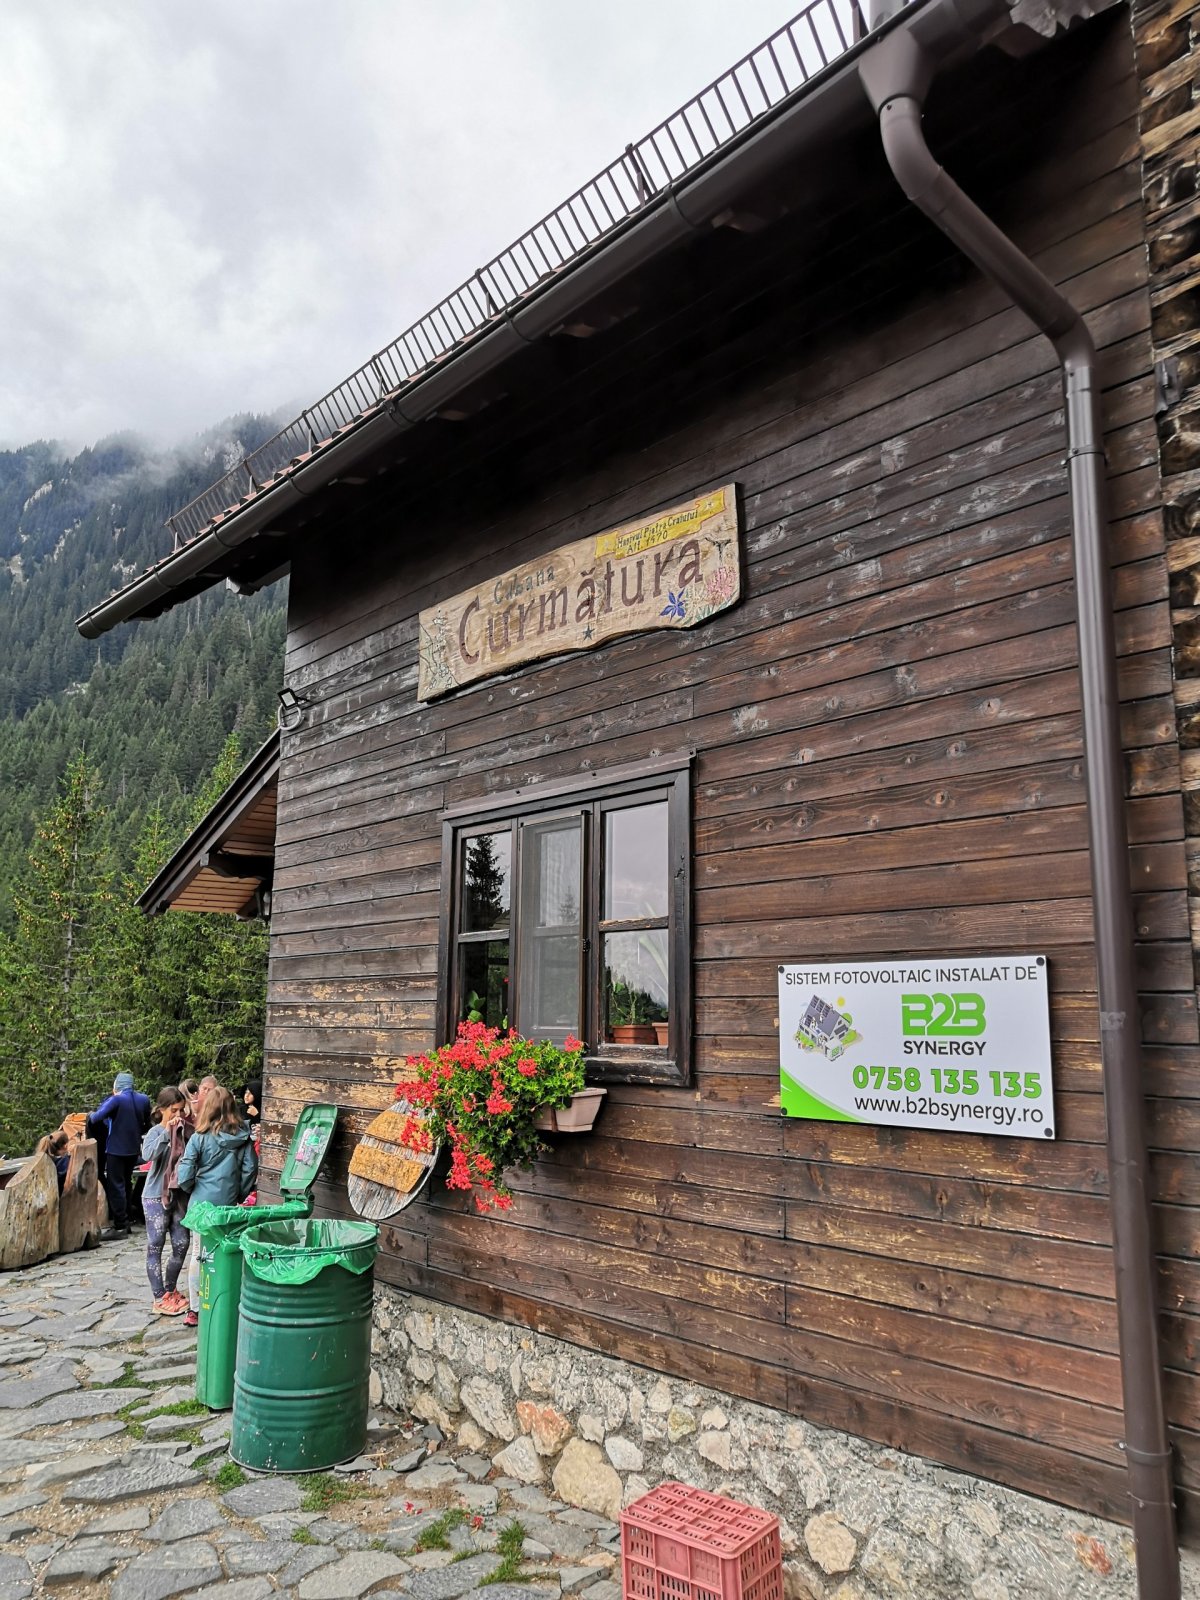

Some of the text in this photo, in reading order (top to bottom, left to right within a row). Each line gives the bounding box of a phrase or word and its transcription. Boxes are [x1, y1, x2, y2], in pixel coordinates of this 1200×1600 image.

[667, 509, 699, 528] Craiului
[493, 565, 555, 604] Cabana
[458, 538, 704, 665] Curmătura
[785, 965, 1038, 985] SISTEM FOTOVOLTAIC INSTALAT DE
[901, 992, 987, 1037] B2B
[903, 1040, 987, 1056] SYNERGY
[852, 1065, 1043, 1098] 0758 135 135
[854, 1096, 1044, 1126] www.b2bsynergy.ro
